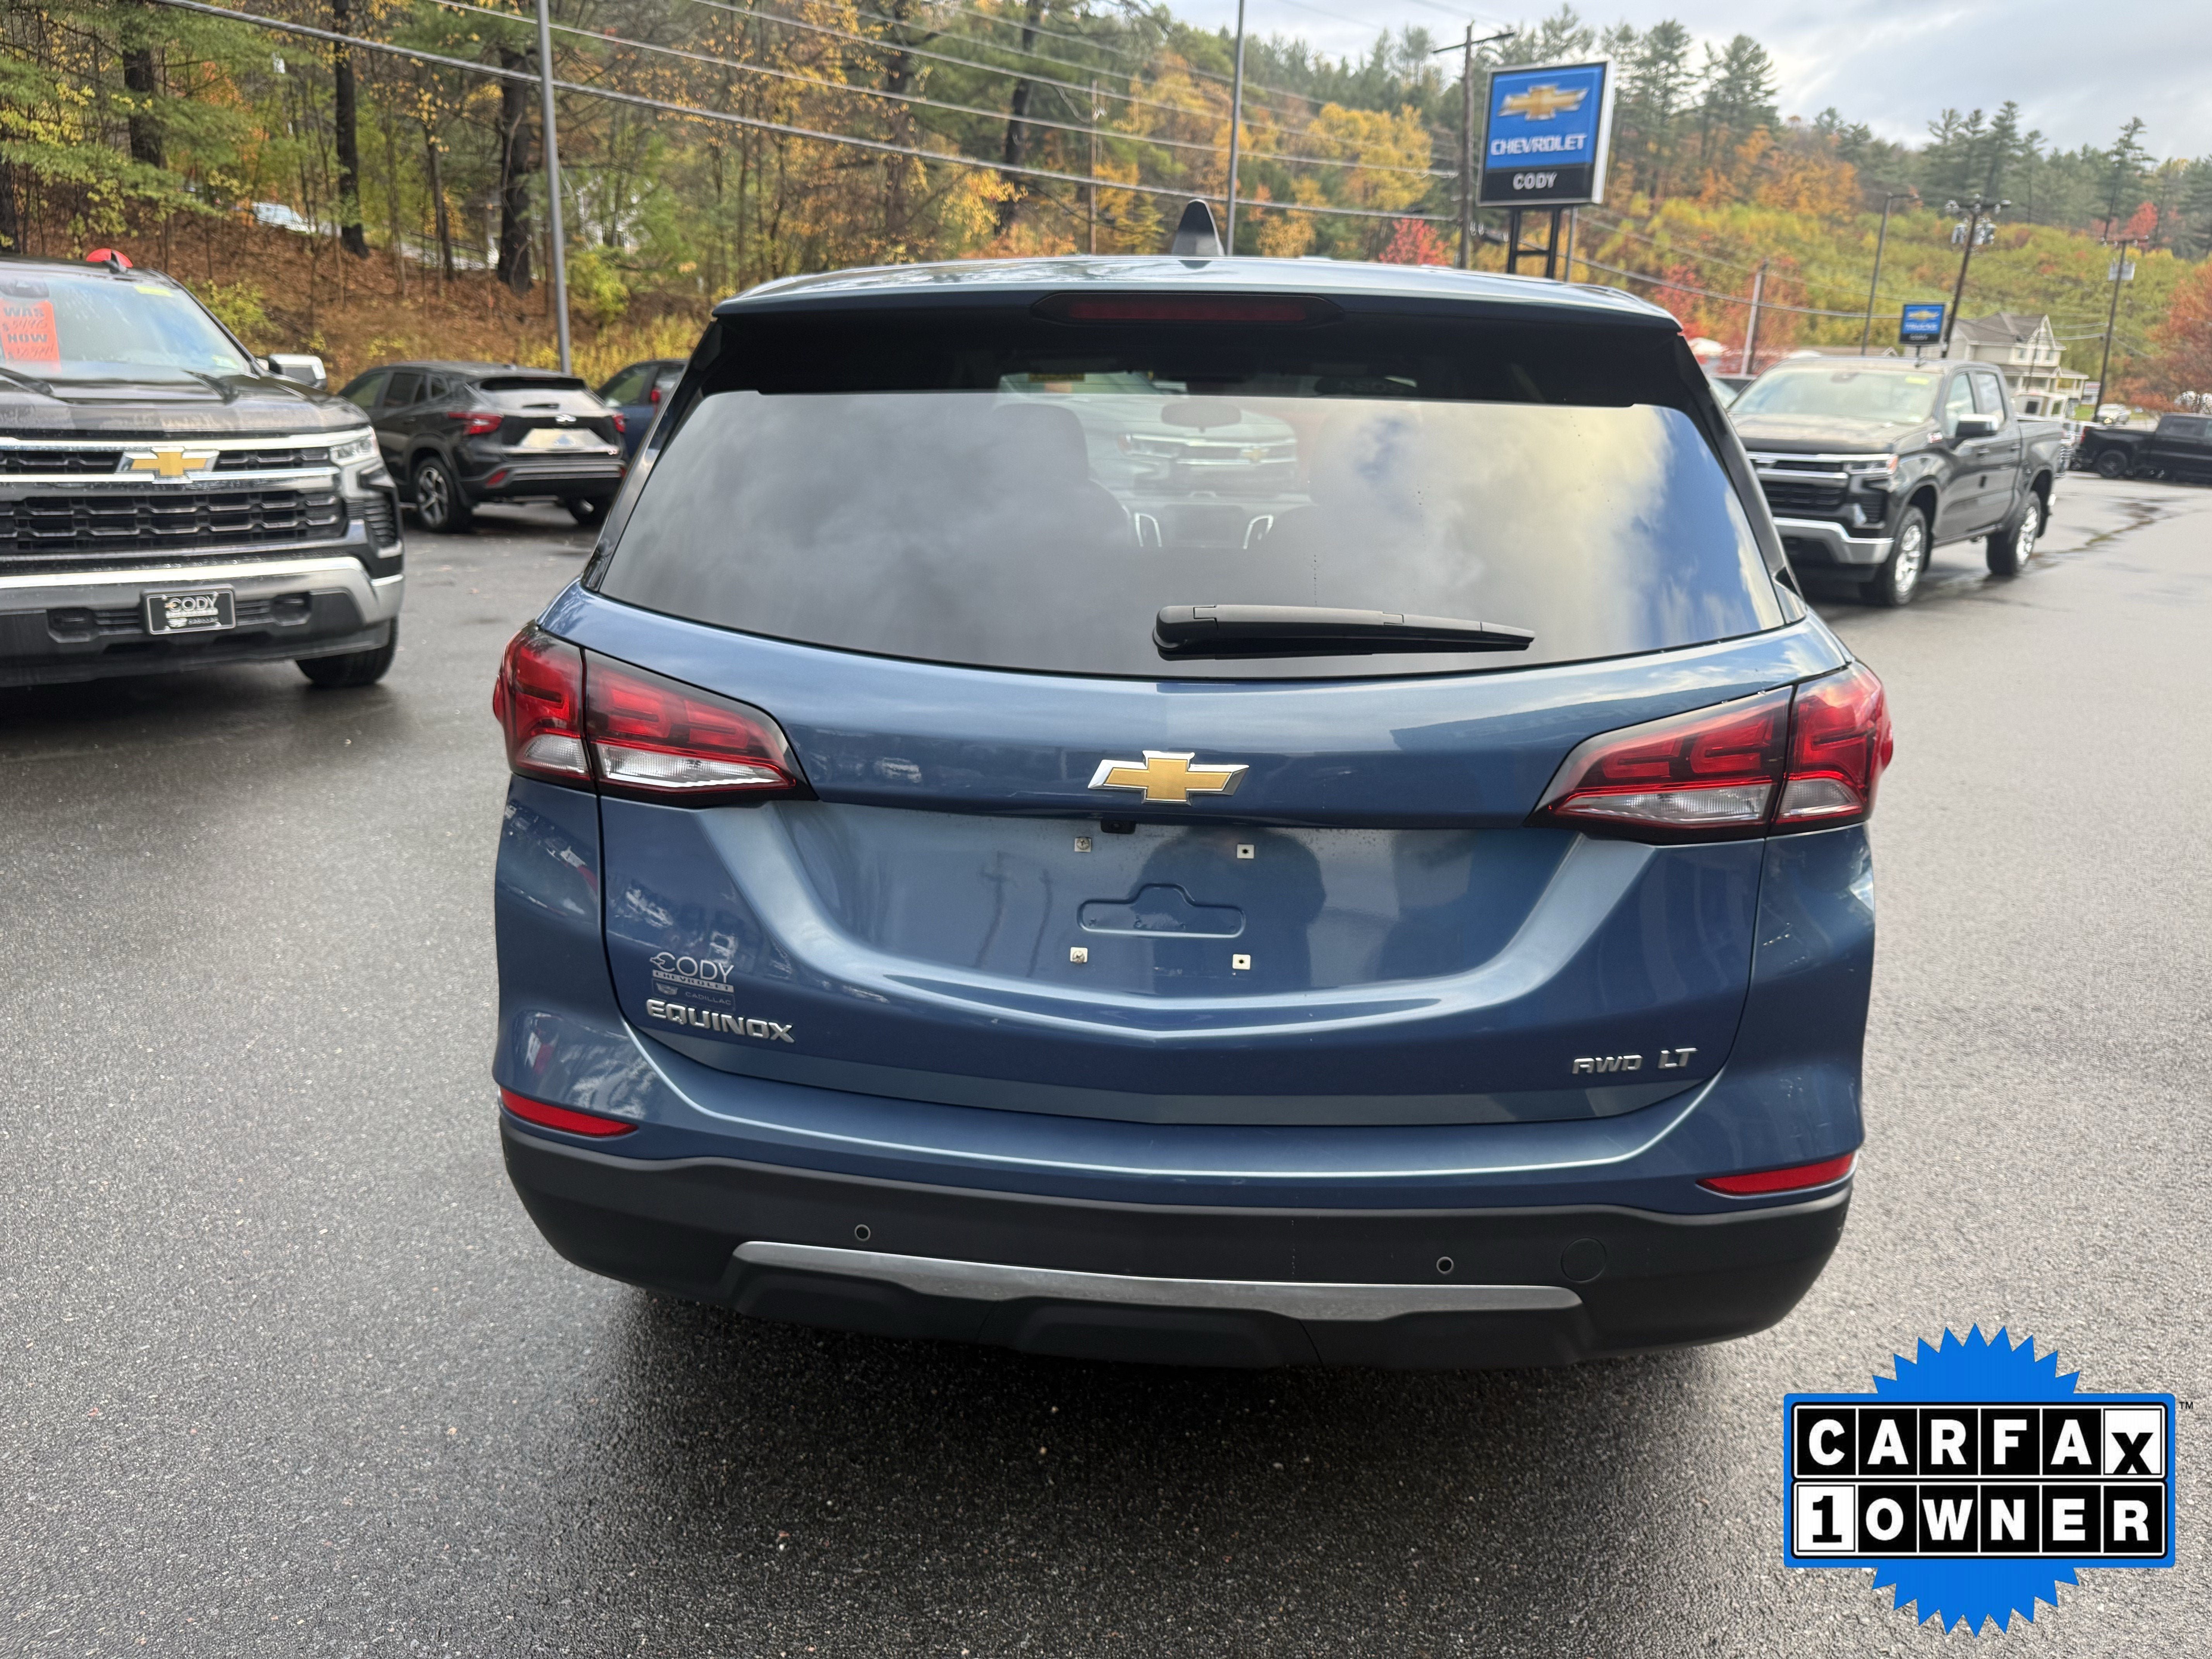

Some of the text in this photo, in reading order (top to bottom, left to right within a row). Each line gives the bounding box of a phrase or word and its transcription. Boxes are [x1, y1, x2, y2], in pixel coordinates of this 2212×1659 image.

[1490, 133, 1587, 155] CHEVROLET
[1513, 172, 1558, 190] CODY
[3, 307, 45, 317] WAS
[8, 333, 47, 343] NOW
[165, 596, 218, 612] CODY
[650, 952, 734, 983] CODY
[655, 971, 731, 991] CHEVROLET
[685, 991, 732, 1006] CADILLAC
[646, 999, 795, 1043] EQUINOX
[1572, 1048, 1698, 1074] AWD LT
